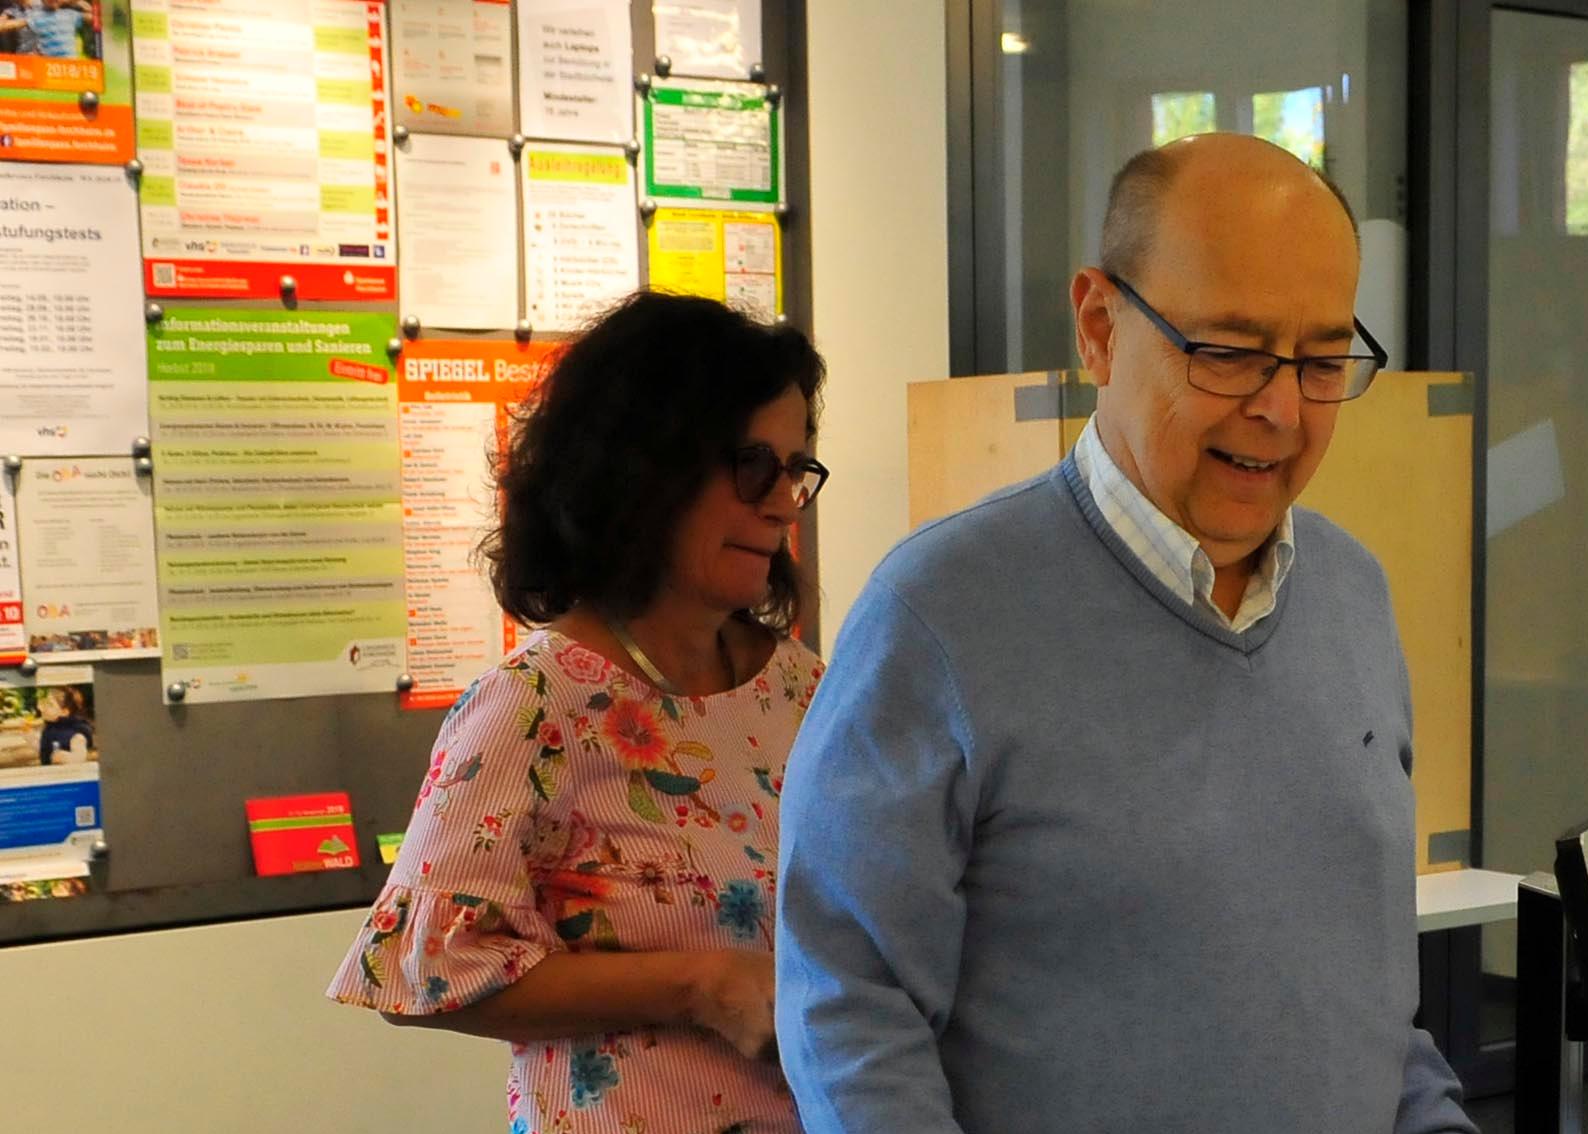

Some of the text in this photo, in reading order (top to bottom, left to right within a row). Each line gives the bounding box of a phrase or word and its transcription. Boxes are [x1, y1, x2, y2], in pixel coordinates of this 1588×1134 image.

[158, 316, 350, 338] nformationsveranstaltungen
[156, 336, 372, 355] zum Energiesparen und Sanieren
[404, 358, 490, 382] SPIEGEL
